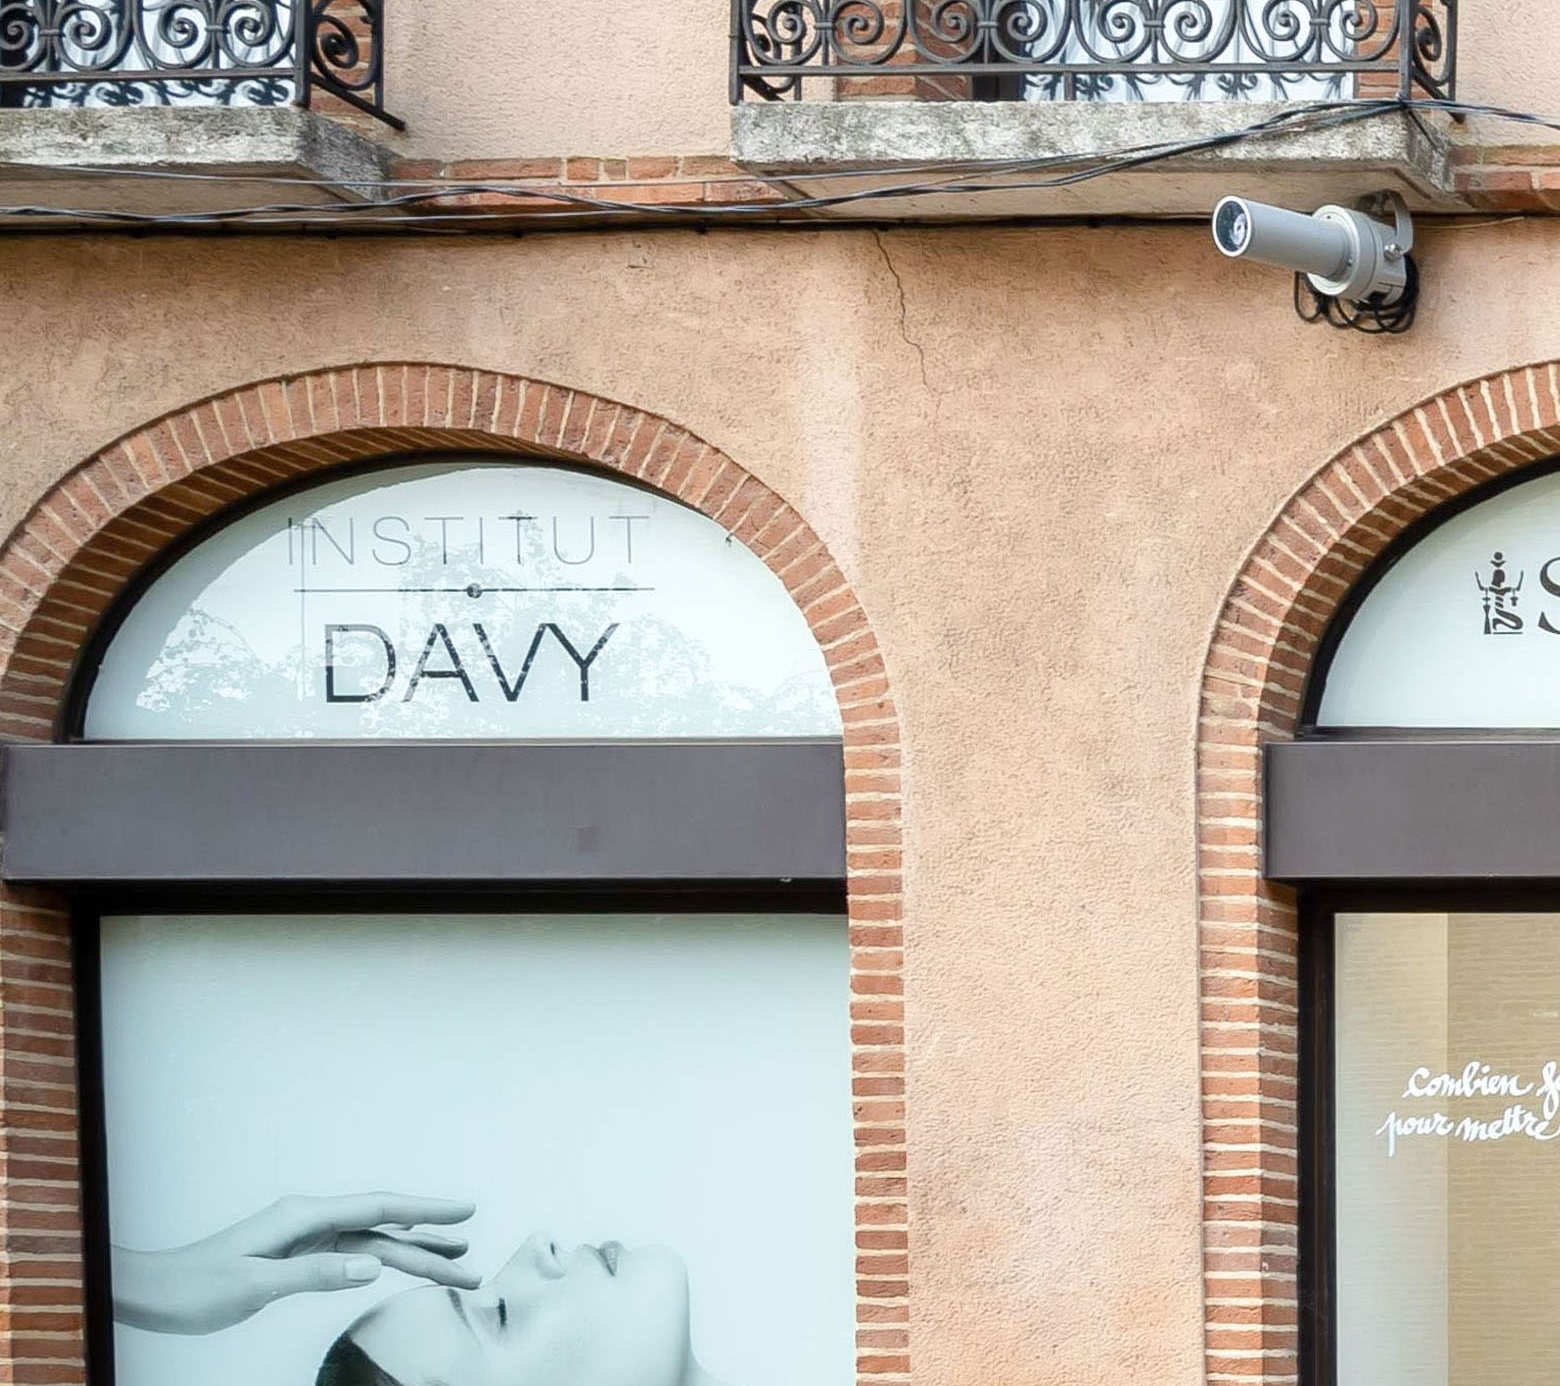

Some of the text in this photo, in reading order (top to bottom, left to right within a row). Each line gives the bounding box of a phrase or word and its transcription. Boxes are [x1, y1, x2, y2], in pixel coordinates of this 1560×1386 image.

[287, 515, 651, 566] INSTITUT
[324, 622, 620, 703] DAVY
[1376, 1111, 1455, 1157] pour
